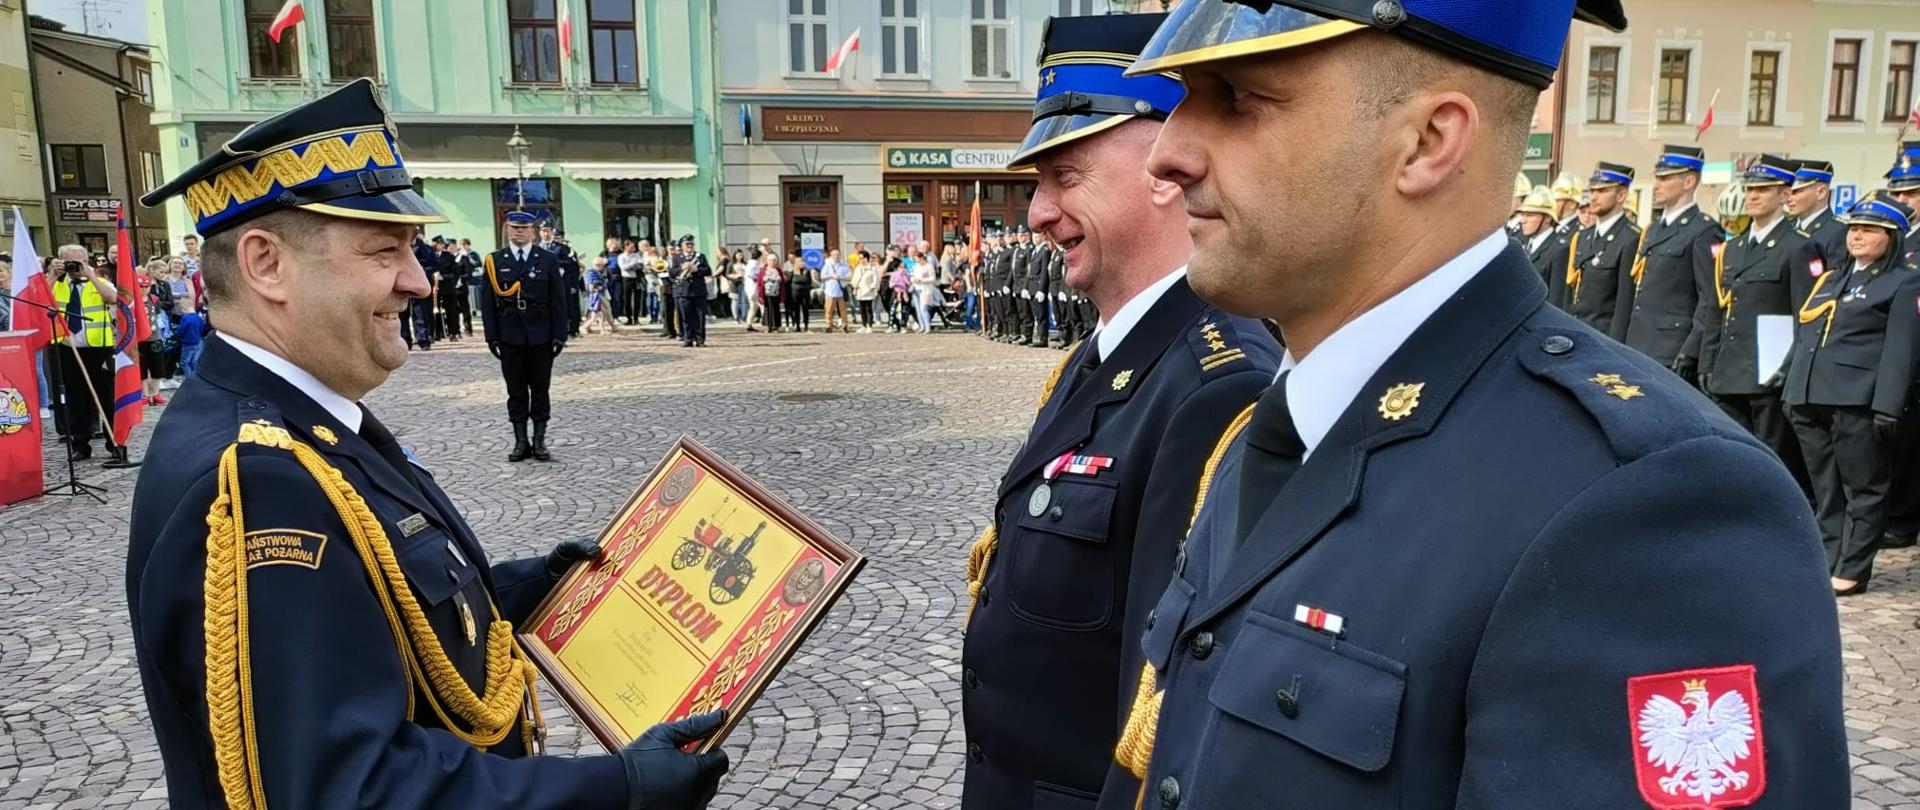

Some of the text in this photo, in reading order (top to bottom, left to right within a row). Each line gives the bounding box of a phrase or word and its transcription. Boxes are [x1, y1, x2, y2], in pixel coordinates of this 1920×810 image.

[909, 152, 949, 165] KASA
[1838, 188, 1850, 207] P
[246, 535, 302, 551] AŃSTWOWA
[264, 547, 313, 562] POŻARNA
[636, 564, 723, 644] DYPLOM
